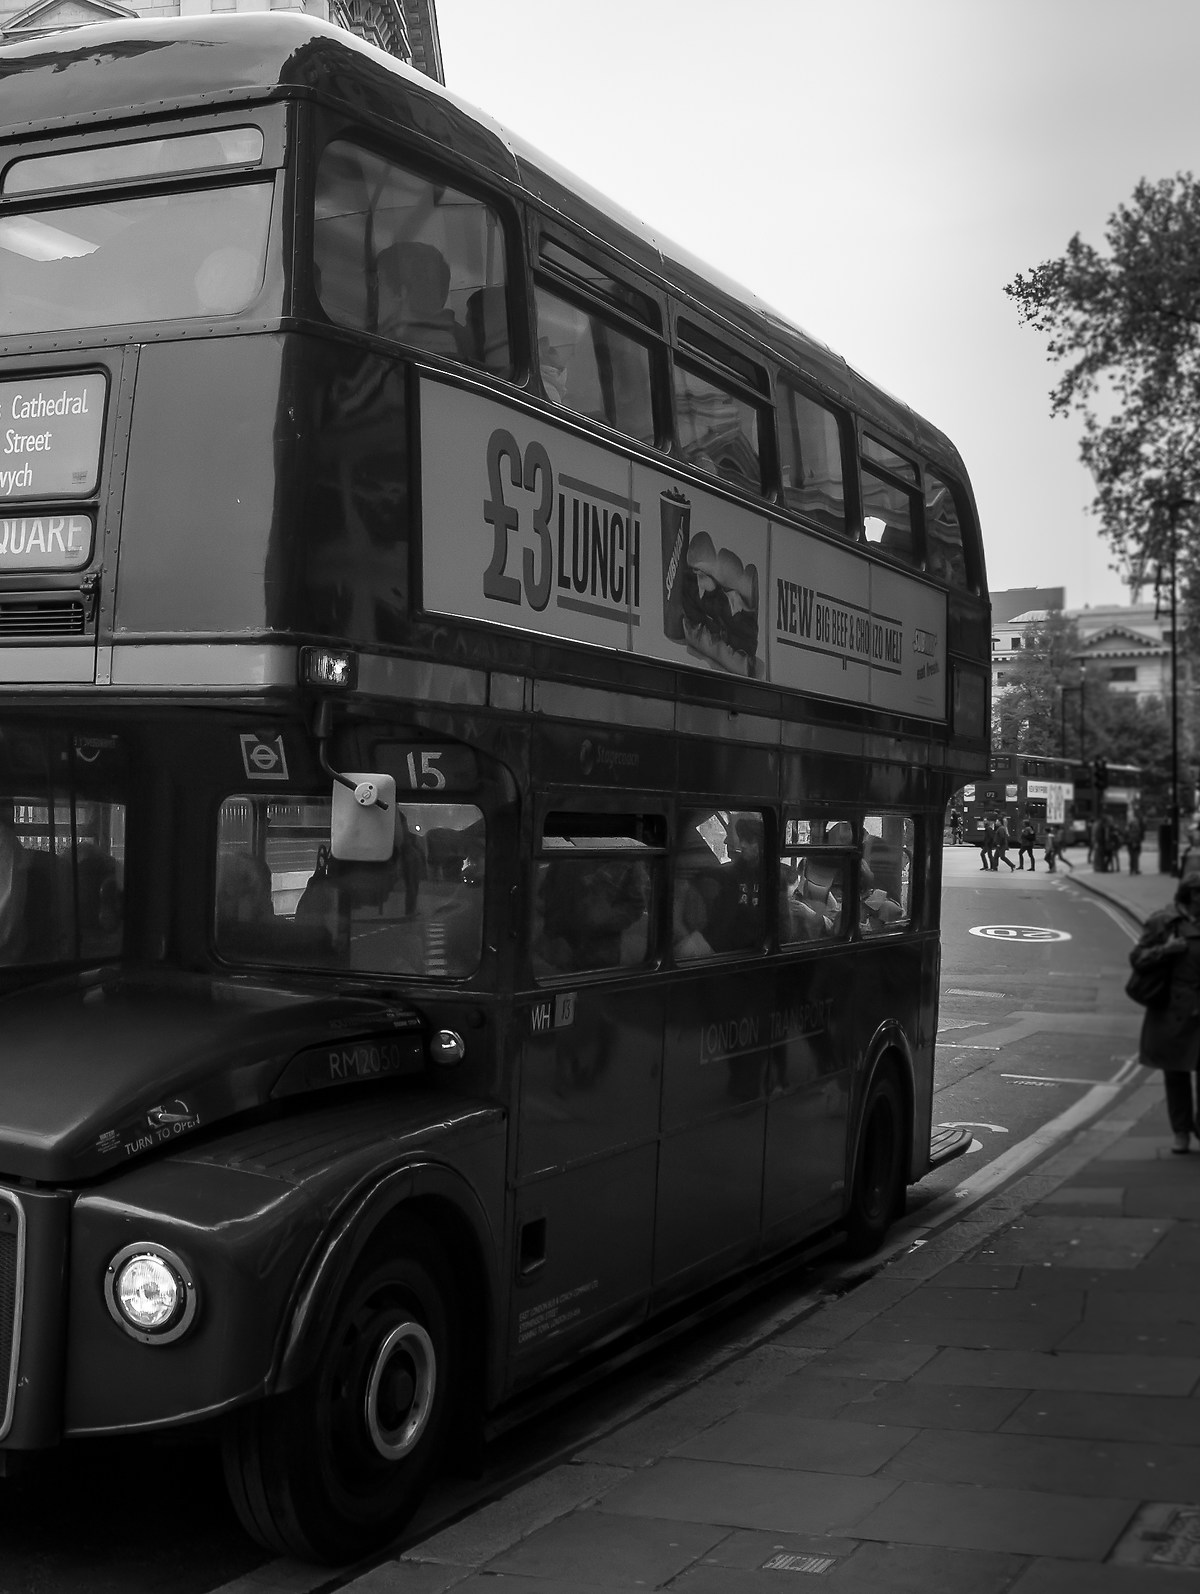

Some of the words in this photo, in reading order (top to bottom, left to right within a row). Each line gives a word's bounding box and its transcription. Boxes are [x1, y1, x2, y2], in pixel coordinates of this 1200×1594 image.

[11, 389, 89, 420] Cathedral
[4, 429, 52, 455] Street
[484, 428, 553, 612] £3
[557, 493, 640, 607] LUNCH
[777, 578, 815, 638] NEW
[816, 604, 830, 642] BIG
[832, 608, 848, 648] BEEF
[849, 614, 855, 652] &
[856, 616, 883, 660] CHOIZO
[885, 628, 903, 665] MELT
[406, 752, 447, 790] 15
[531, 1002, 551, 1031] WH
[700, 1016, 759, 1062] LONDON
[769, 998, 834, 1040] TRANSPORT
[124, 1134, 153, 1155] TURN
[156, 1127, 171, 1141] TO
